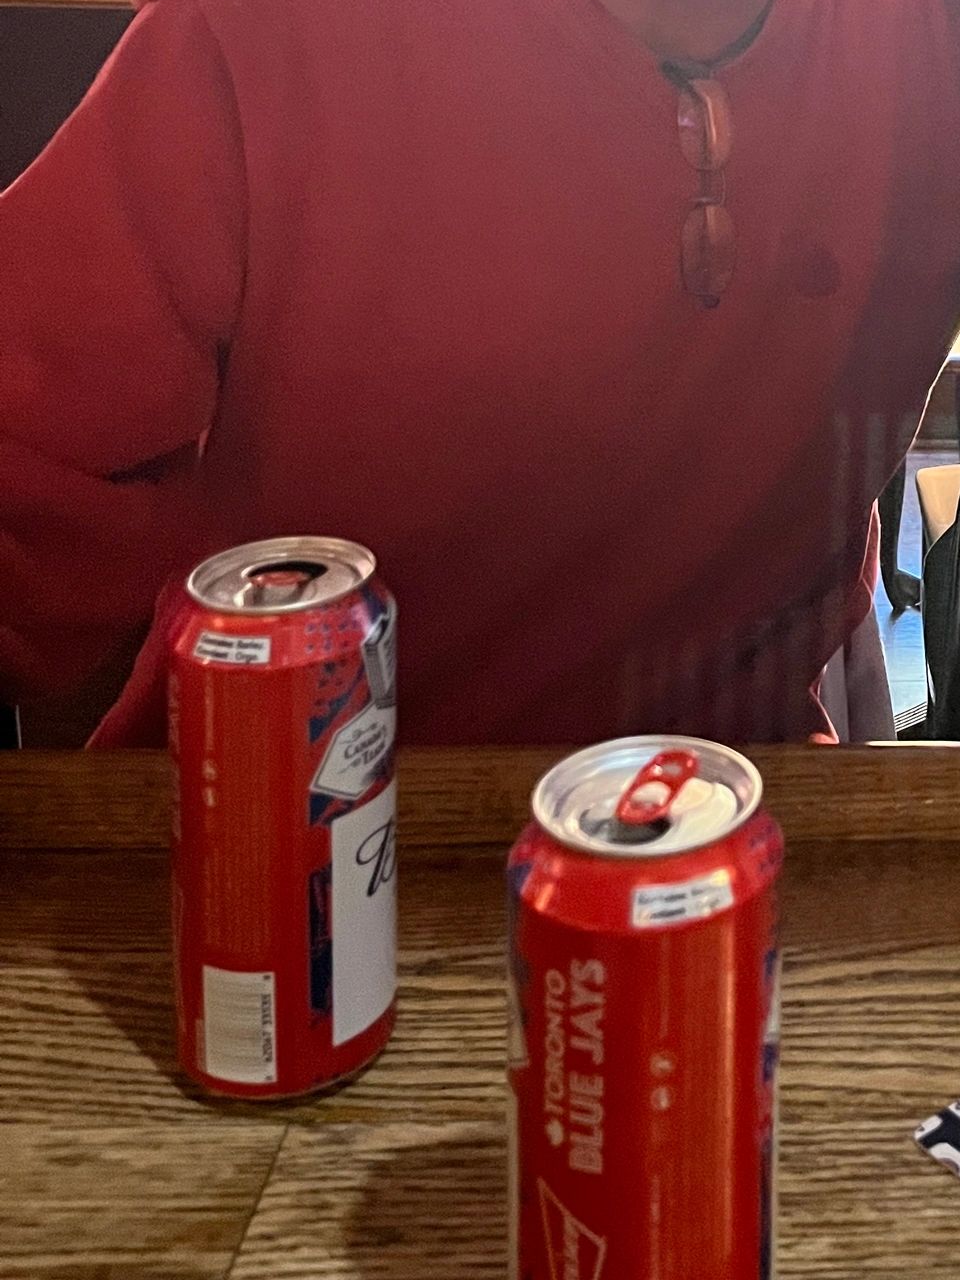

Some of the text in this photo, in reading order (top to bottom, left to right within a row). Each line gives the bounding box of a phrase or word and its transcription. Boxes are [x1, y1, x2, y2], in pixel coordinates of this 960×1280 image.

[545, 969, 566, 1114] TORONTO
[569, 958, 606, 1174] BLUE JAYS
